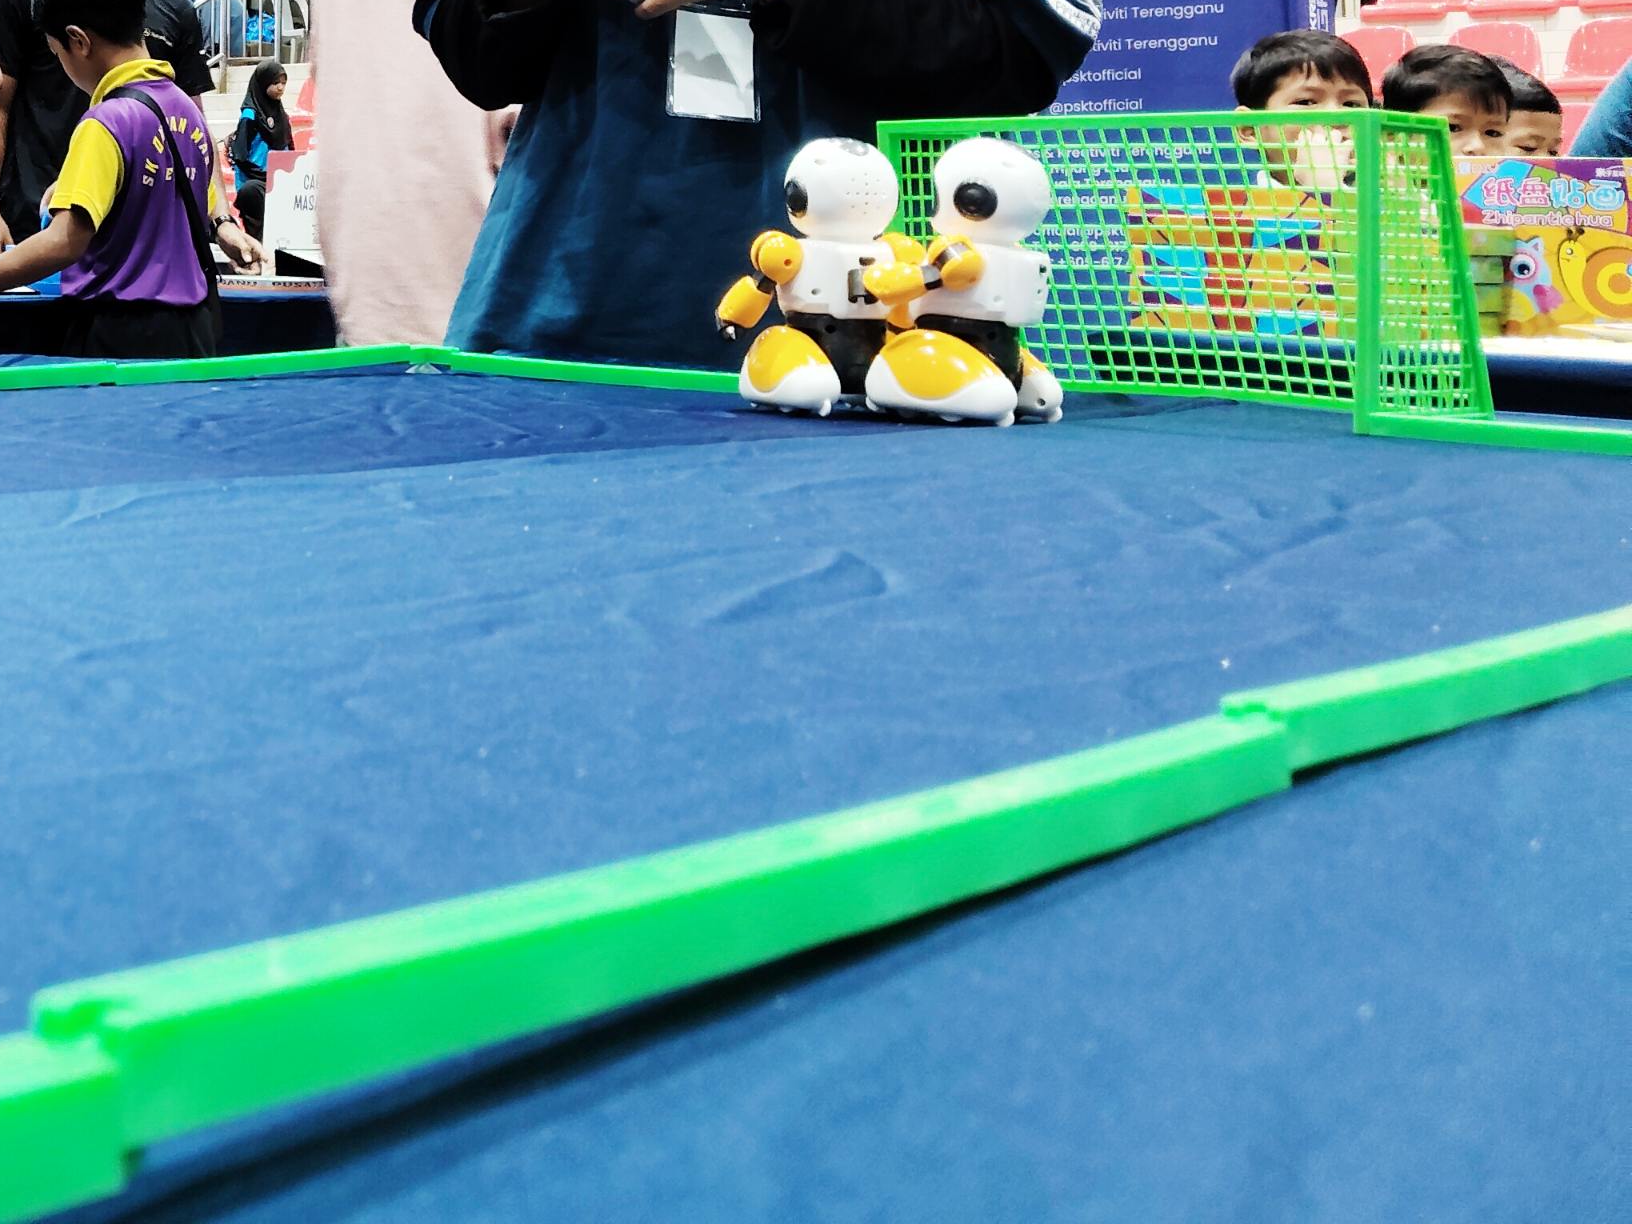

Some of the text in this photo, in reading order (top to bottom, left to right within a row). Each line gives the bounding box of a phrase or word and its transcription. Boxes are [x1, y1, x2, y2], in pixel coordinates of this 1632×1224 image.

[1132, 2, 1225, 20] Terengganu
[1125, 35, 1219, 52] Terengganu
[1049, 97, 1143, 115] @psktofficial
[1482, 177, 1626, 212] 纸盘贴画
